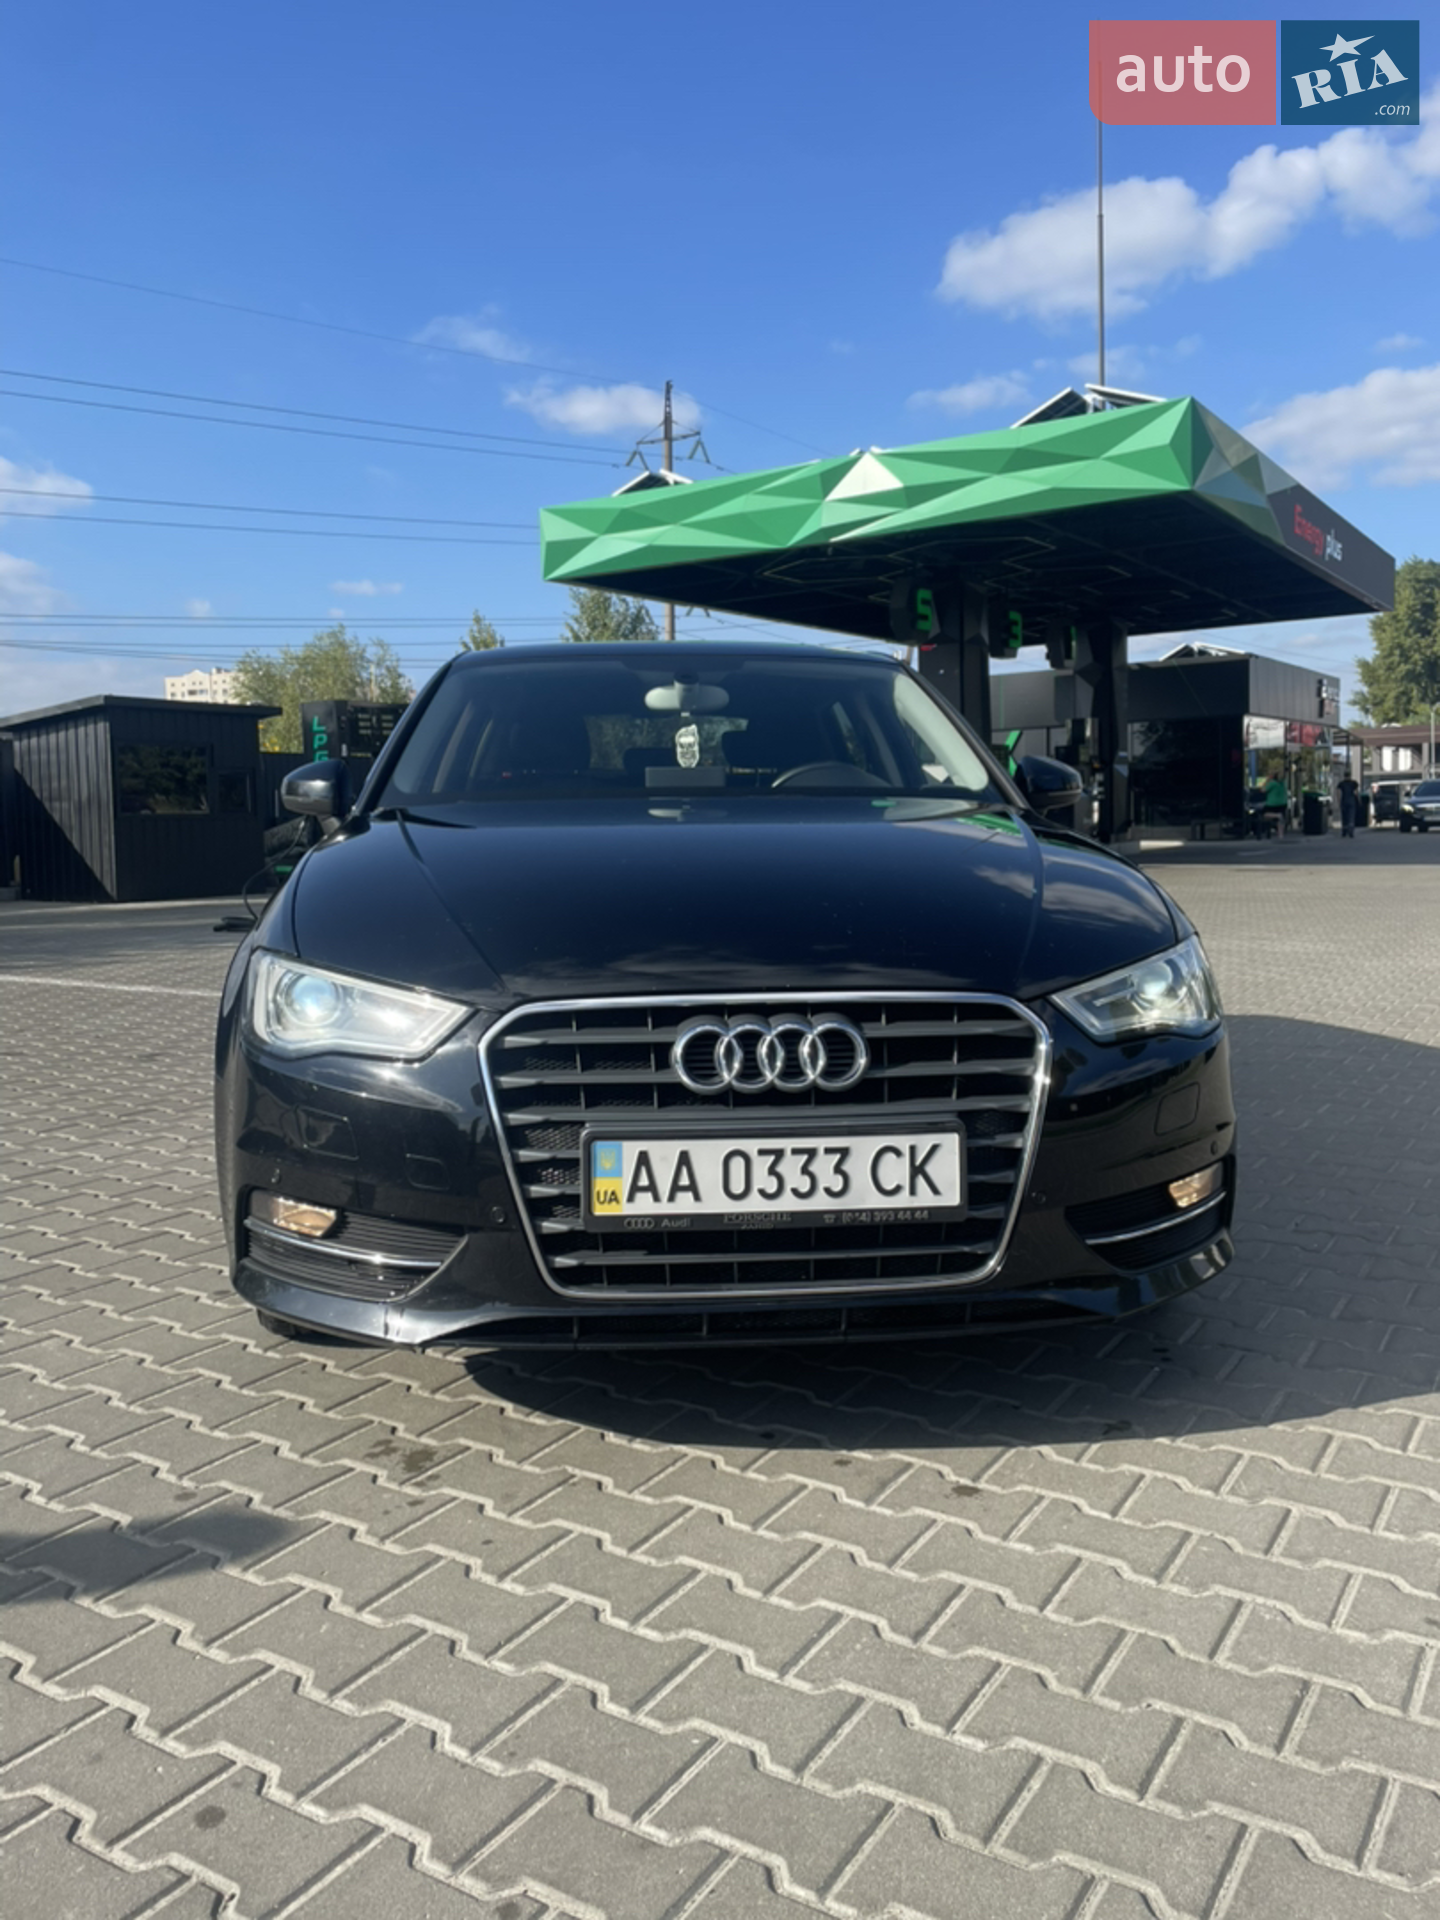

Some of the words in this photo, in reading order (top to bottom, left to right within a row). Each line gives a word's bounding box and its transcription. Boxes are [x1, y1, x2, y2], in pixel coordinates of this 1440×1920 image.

[1294, 504, 1323, 555] Energy
[1325, 529, 1342, 561] plus
[1008, 611, 1022, 648] 3
[313, 716, 328, 764] LPG
[626, 1150, 702, 1203] AA
[722, 1147, 850, 1201] 0333
[869, 1143, 942, 1198] CK
[596, 1191, 620, 1205] UA
[661, 1218, 691, 1228] Audi
